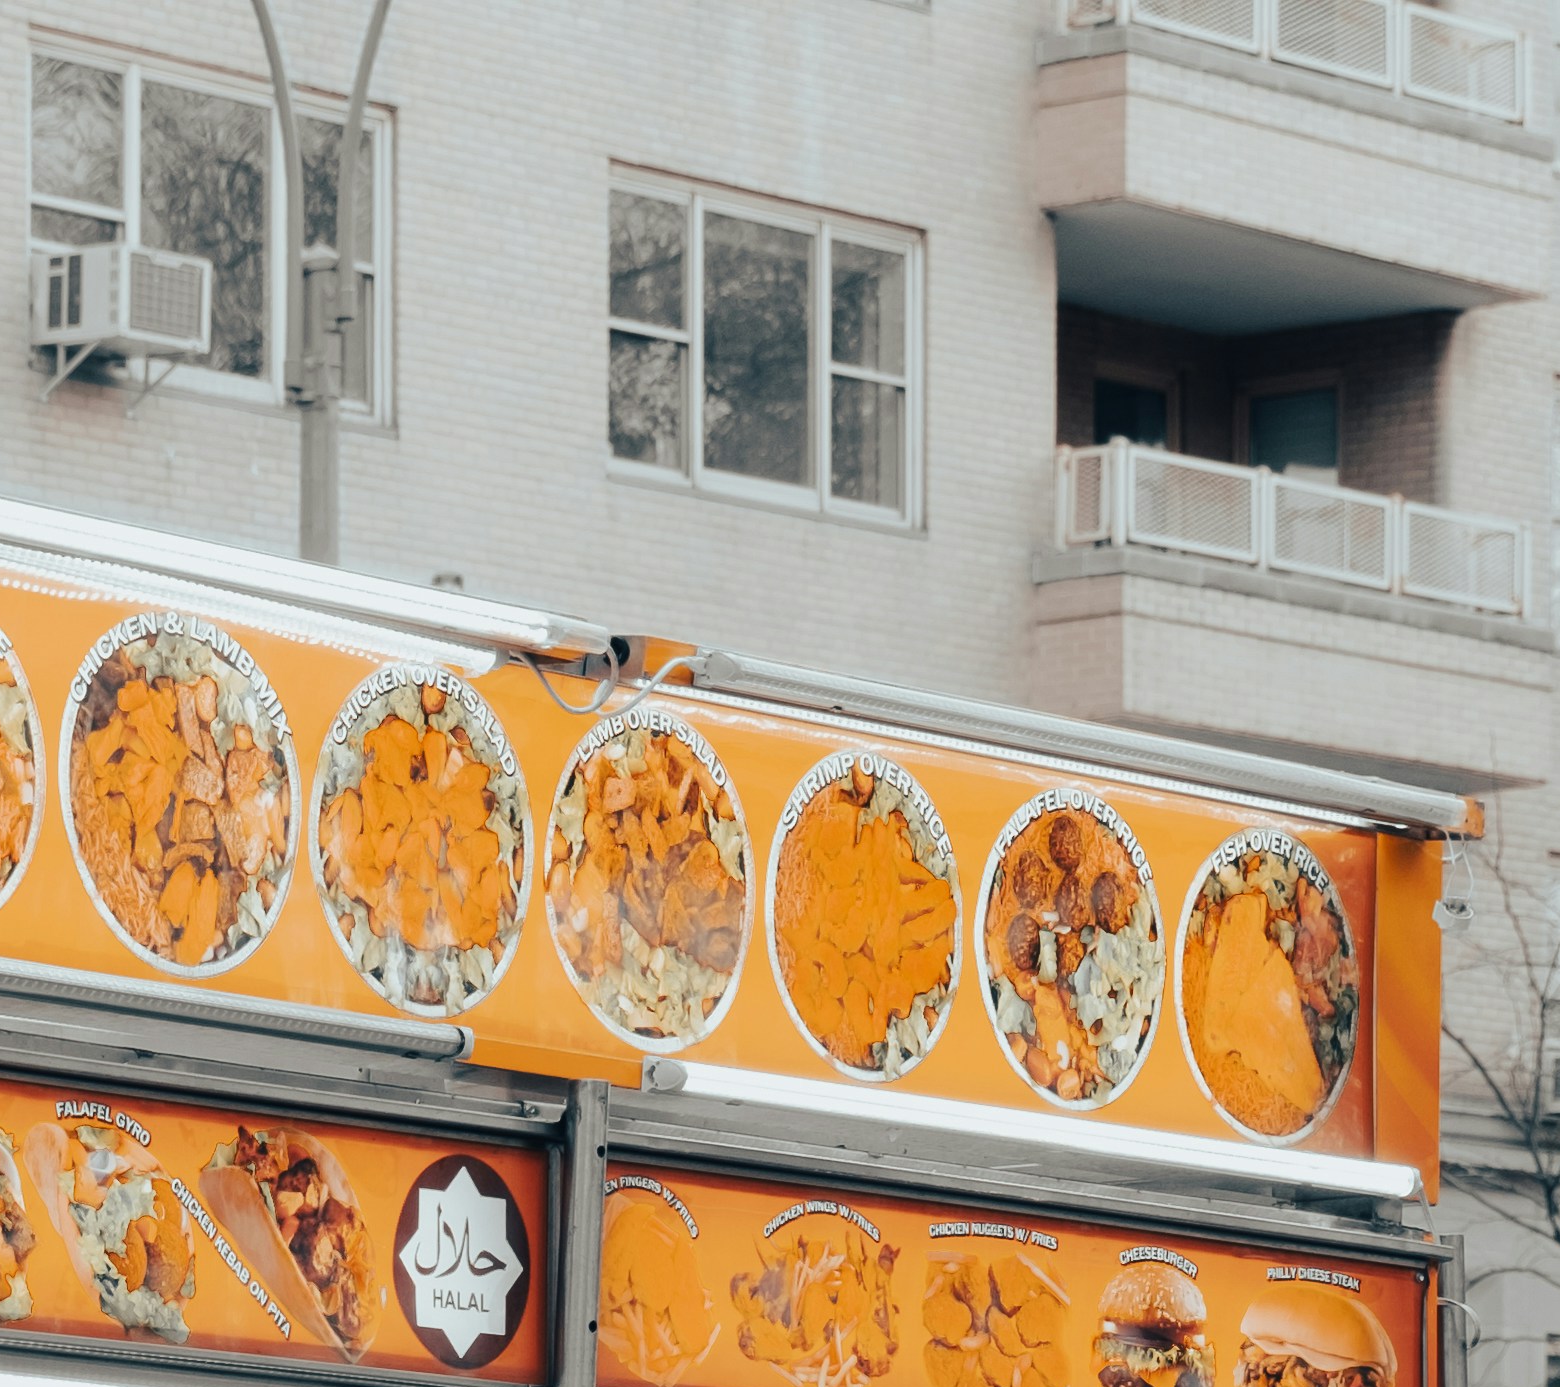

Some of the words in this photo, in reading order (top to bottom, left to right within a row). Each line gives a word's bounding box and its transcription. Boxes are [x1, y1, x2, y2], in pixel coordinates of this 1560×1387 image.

[69, 612, 158, 703] CHICKEN
[163, 610, 184, 635] &
[190, 616, 255, 677] LAMB
[254, 678, 294, 742] MIX
[782, 755, 855, 830] SHRIMP
[859, 755, 914, 796] OVER
[914, 791, 952, 860] RICE
[1211, 833, 1248, 874] FISH
[1250, 830, 1293, 857] OVER
[1294, 847, 1329, 894] RICE
[55, 1100, 113, 1124] FALAFEL
[113, 1109, 152, 1147] GYRO
[171, 1177, 217, 1239] CHICKEN
[213, 1234, 252, 1285] KEBAB
[248, 1281, 269, 1307] ON
[266, 1303, 292, 1340] PITA
[413, 1202, 508, 1279] حلال
[928, 1222, 970, 1238] CHICKEN
[971, 1222, 1014, 1239] NUGGETS
[1031, 1232, 1058, 1250] FRIES
[1119, 1246, 1198, 1279] CHEESEBURGER
[432, 1288, 491, 1313] HALAL
[1266, 1266, 1297, 1282] PHILLY
[1297, 1268, 1331, 1284] CHEESE
[1331, 1273, 1361, 1291] STEAK
